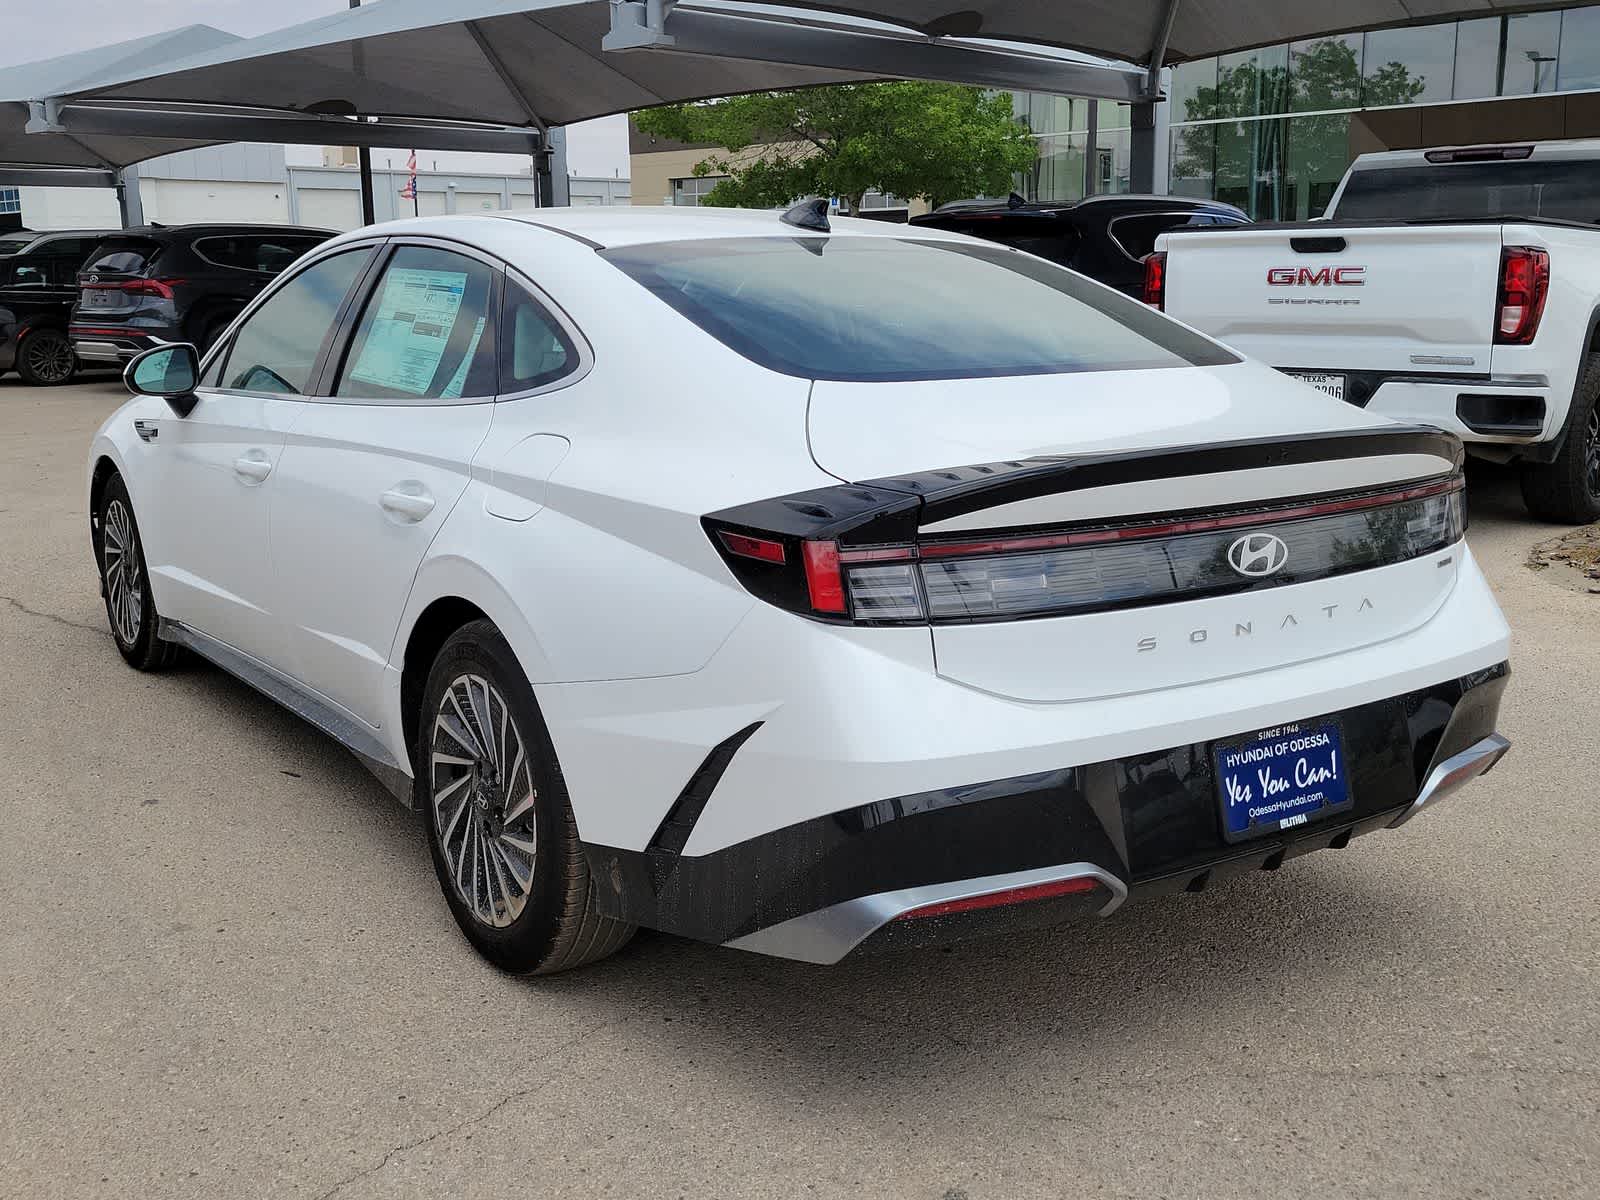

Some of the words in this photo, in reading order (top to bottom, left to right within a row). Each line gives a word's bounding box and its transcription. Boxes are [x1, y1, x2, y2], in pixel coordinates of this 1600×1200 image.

[1266, 267, 1366, 287] GMC
[1302, 375, 1327, 383] TEXAS
[1136, 598, 1374, 652] SONATA
[1258, 728, 1281, 741] SINCE
[1282, 725, 1299, 736] 1946
[1226, 746, 1274, 768] HYUNDAI
[1275, 743, 1288, 756] OF
[1290, 733, 1330, 751] ODESSA
[1225, 774, 1252, 807] Yes
[1258, 766, 1290, 798] You
[1295, 750, 1337, 788] Can!
[1249, 792, 1324, 818] OdessaHyundai.com
